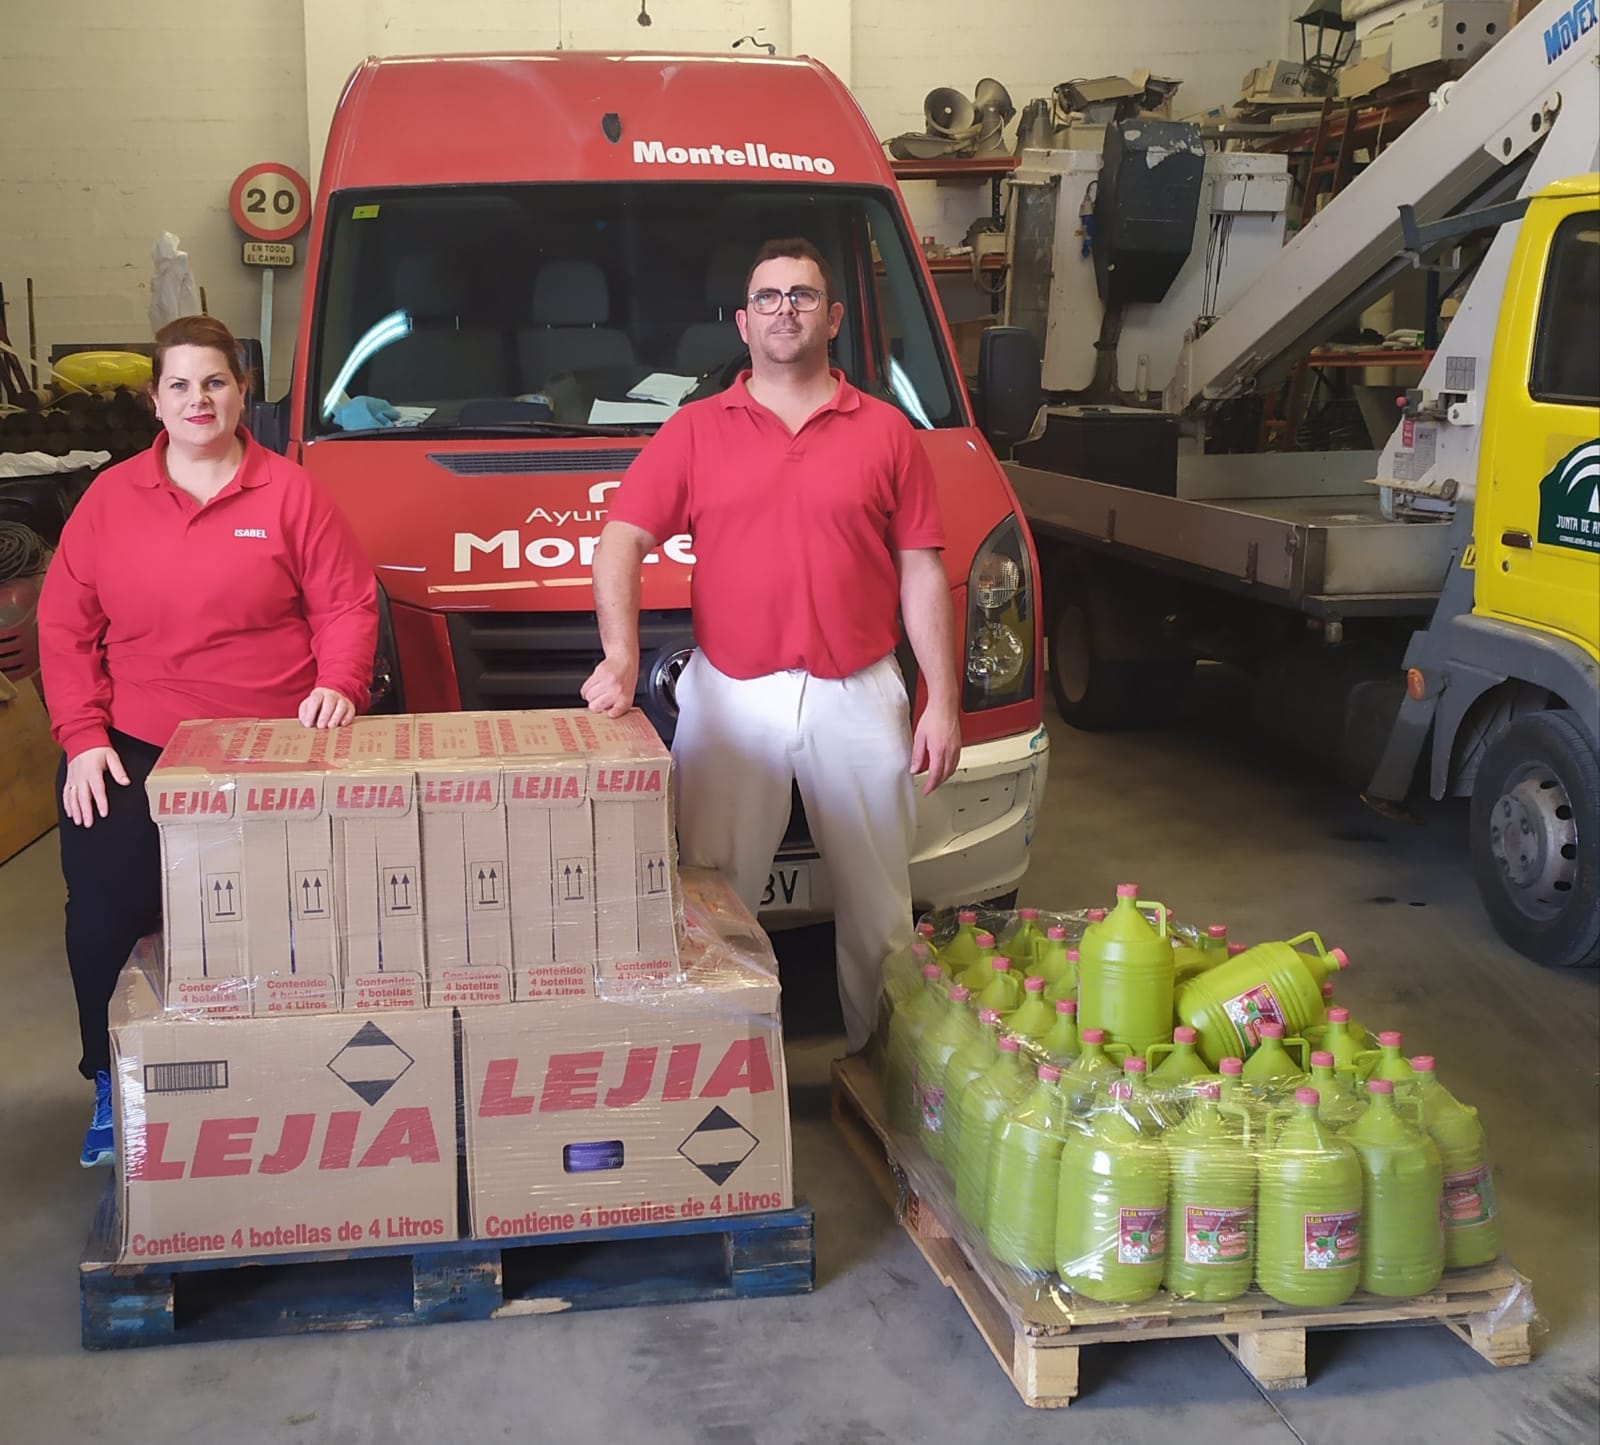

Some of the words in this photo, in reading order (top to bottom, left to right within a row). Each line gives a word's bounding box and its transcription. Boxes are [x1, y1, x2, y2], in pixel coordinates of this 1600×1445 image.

[633, 141, 836, 175] Montellano
[247, 188, 295, 215] 20
[247, 254, 256, 262] EL
[258, 255, 290, 263] CAMINO
[251, 244, 262, 252] EN
[264, 245, 287, 253] TODO
[234, 528, 268, 539] ISABEL
[1556, 515, 1578, 531] JUNTA
[1581, 519, 1590, 533] DE
[512, 776, 580, 800] LEJIA
[596, 770, 661, 793] LEJIA
[247, 788, 316, 811] LEJIA
[336, 785, 405, 810] LEJIA
[425, 780, 493, 804] LEJIA
[158, 791, 228, 815] LEJIA
[267, 978, 328, 989] Contenido:
[446, 982, 452, 991] 4
[456, 982, 499, 991] botellas
[531, 978, 537, 987] 4
[541, 977, 584, 986] botellas
[358, 989, 365, 998] 4
[369, 988, 413, 997] botellas
[443, 993, 457, 1002] de
[460, 993, 467, 1001] 4
[470, 992, 501, 1001] Litros
[528, 989, 542, 997] de
[545, 988, 552, 996] 4
[268, 1003, 282, 1011] de
[286, 1002, 292, 1010] 4
[296, 1001, 327, 1010] Litros
[357, 1000, 370, 1008] de
[478, 1037, 775, 1118] LEJIA
[131, 1106, 441, 1181] LEJIA
[485, 1210, 575, 1237] Contiene
[580, 1207, 593, 1228] 4
[598, 1201, 675, 1225] botellas
[681, 1197, 705, 1218] de
[710, 1195, 723, 1214] 4
[727, 1191, 782, 1214] Litros
[132, 1231, 225, 1257] Contiene
[231, 1228, 244, 1249] 4
[250, 1222, 332, 1249] botellas
[337, 1220, 363, 1242] de
[369, 1218, 382, 1239] 4
[387, 1216, 445, 1238] Litros
